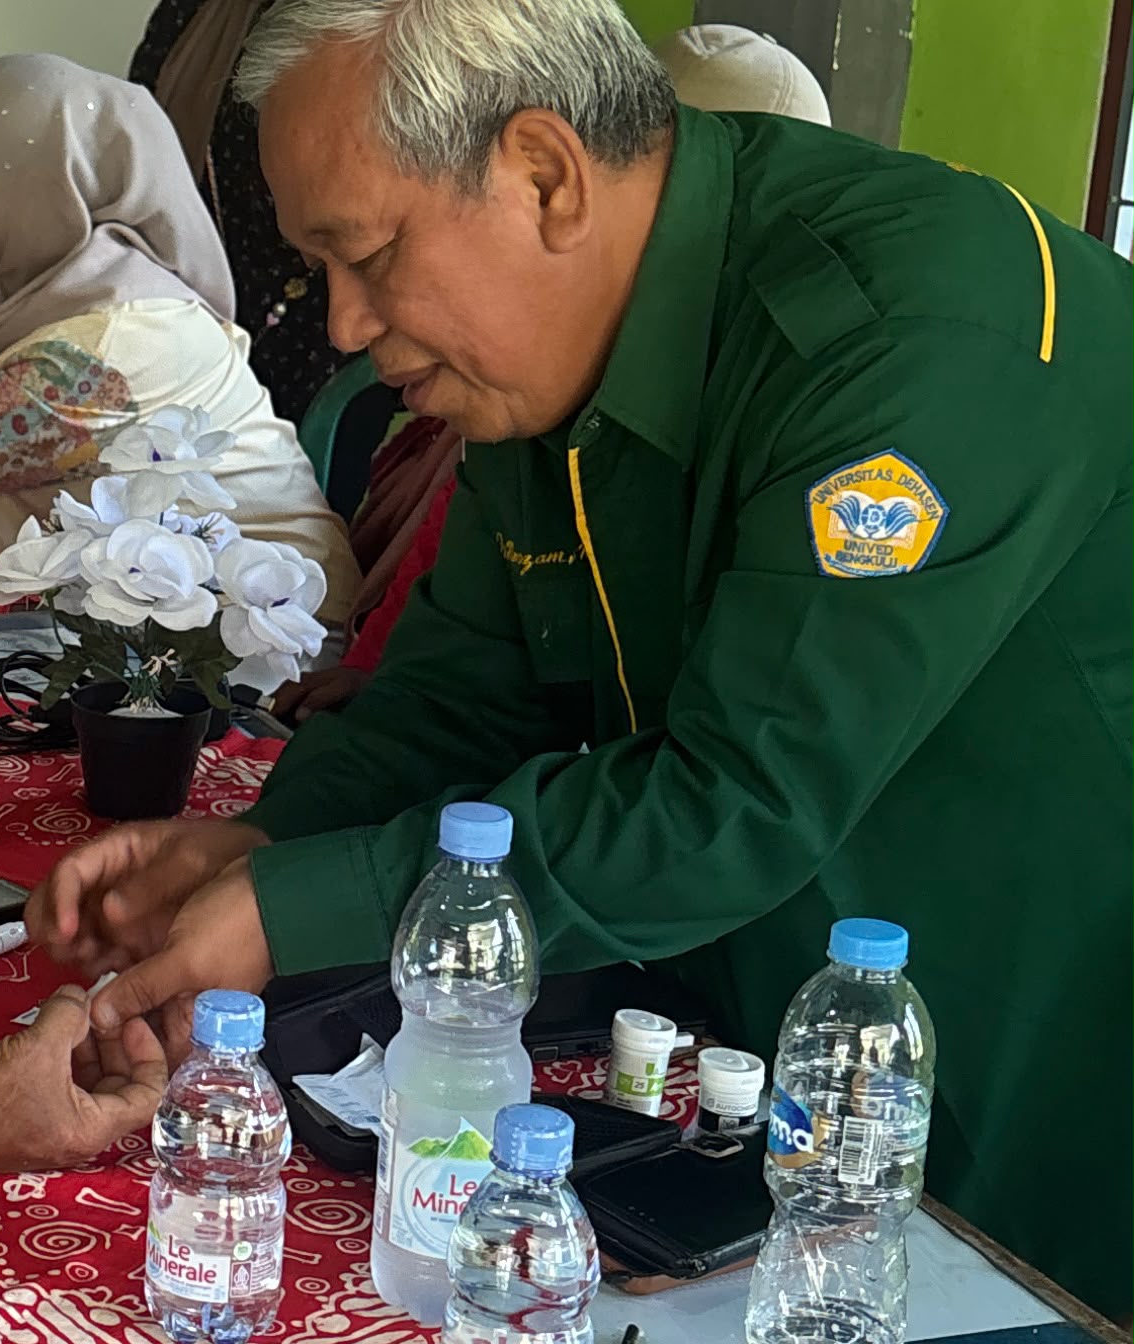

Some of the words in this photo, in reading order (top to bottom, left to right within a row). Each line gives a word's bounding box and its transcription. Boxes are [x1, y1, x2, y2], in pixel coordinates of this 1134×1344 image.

[813, 469, 893, 504] UNIVERSITAS
[897, 474, 939, 520] DEHASEN
[836, 551, 898, 568] BENGKULU
[844, 540, 894, 556] UNIVED
[634, 1081, 646, 1090] 25
[450, 1174, 478, 1197] Le
[168, 1234, 191, 1262] Le
[148, 1241, 217, 1285] Minerale
